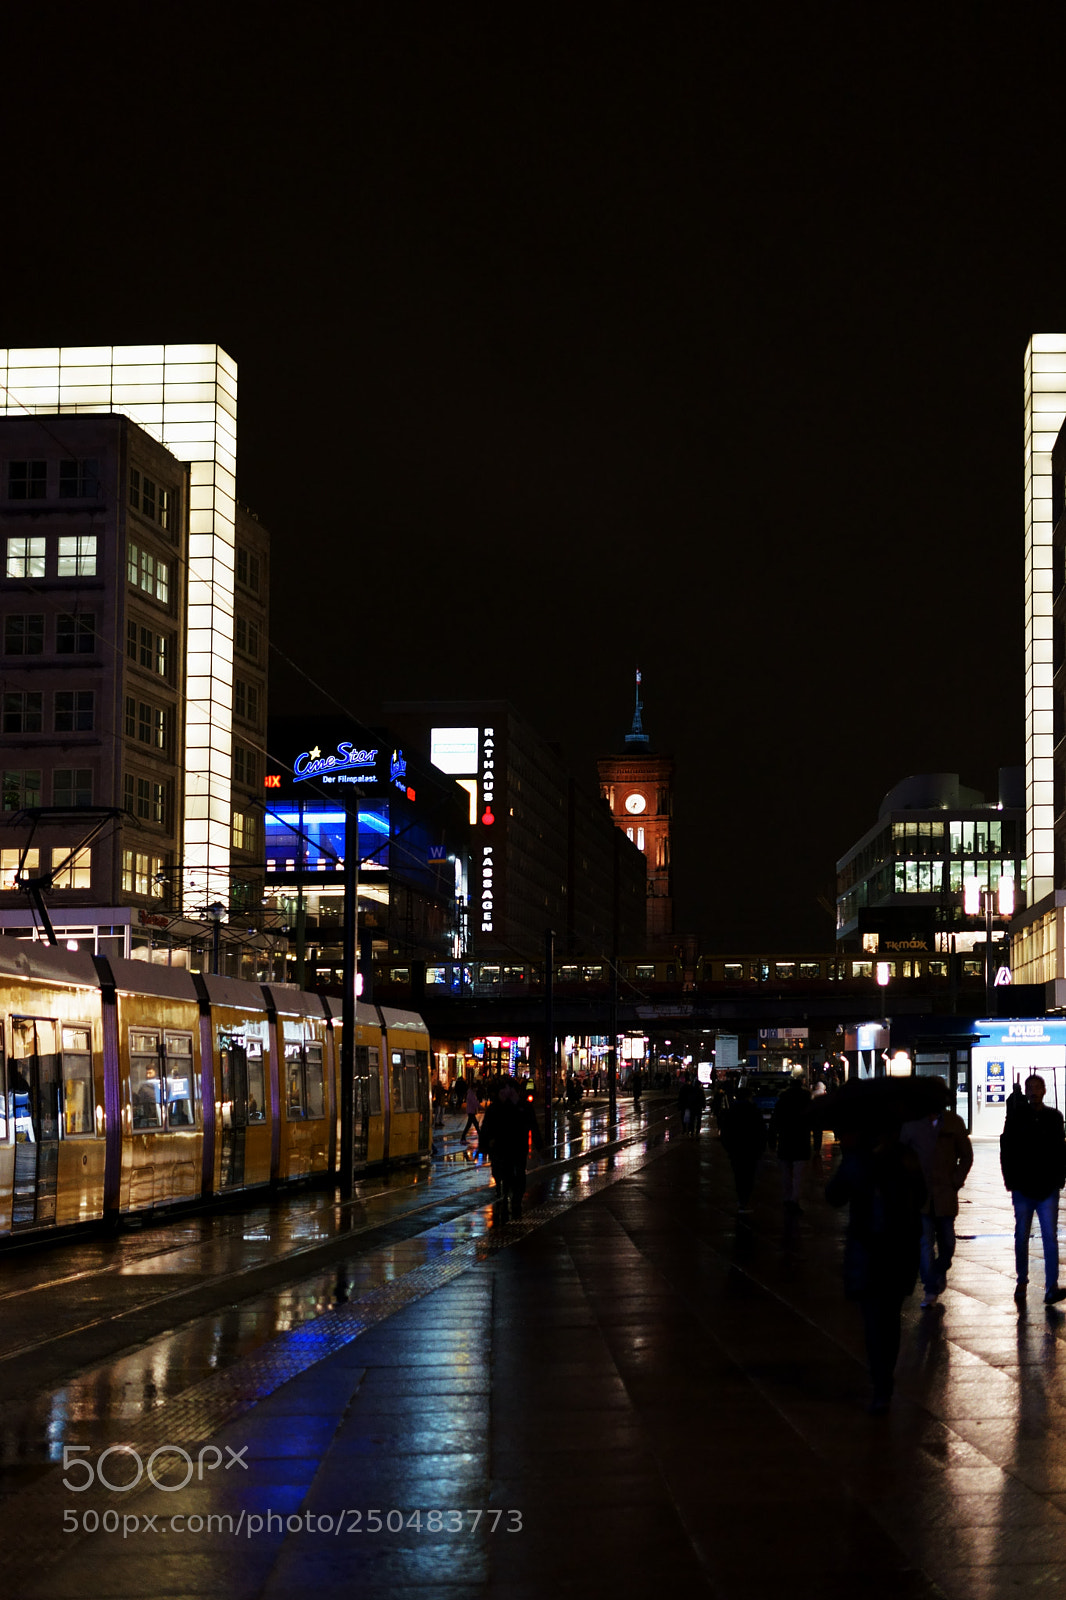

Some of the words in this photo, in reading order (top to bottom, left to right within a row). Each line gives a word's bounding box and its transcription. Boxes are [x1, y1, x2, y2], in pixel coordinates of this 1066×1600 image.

[293, 742, 379, 779] CineStar
[483, 728, 494, 802] RATHAUS
[322, 775, 336, 784] Der
[481, 846, 493, 932] PASSAGEN
[1008, 1025, 1044, 1037] POLIZEI
